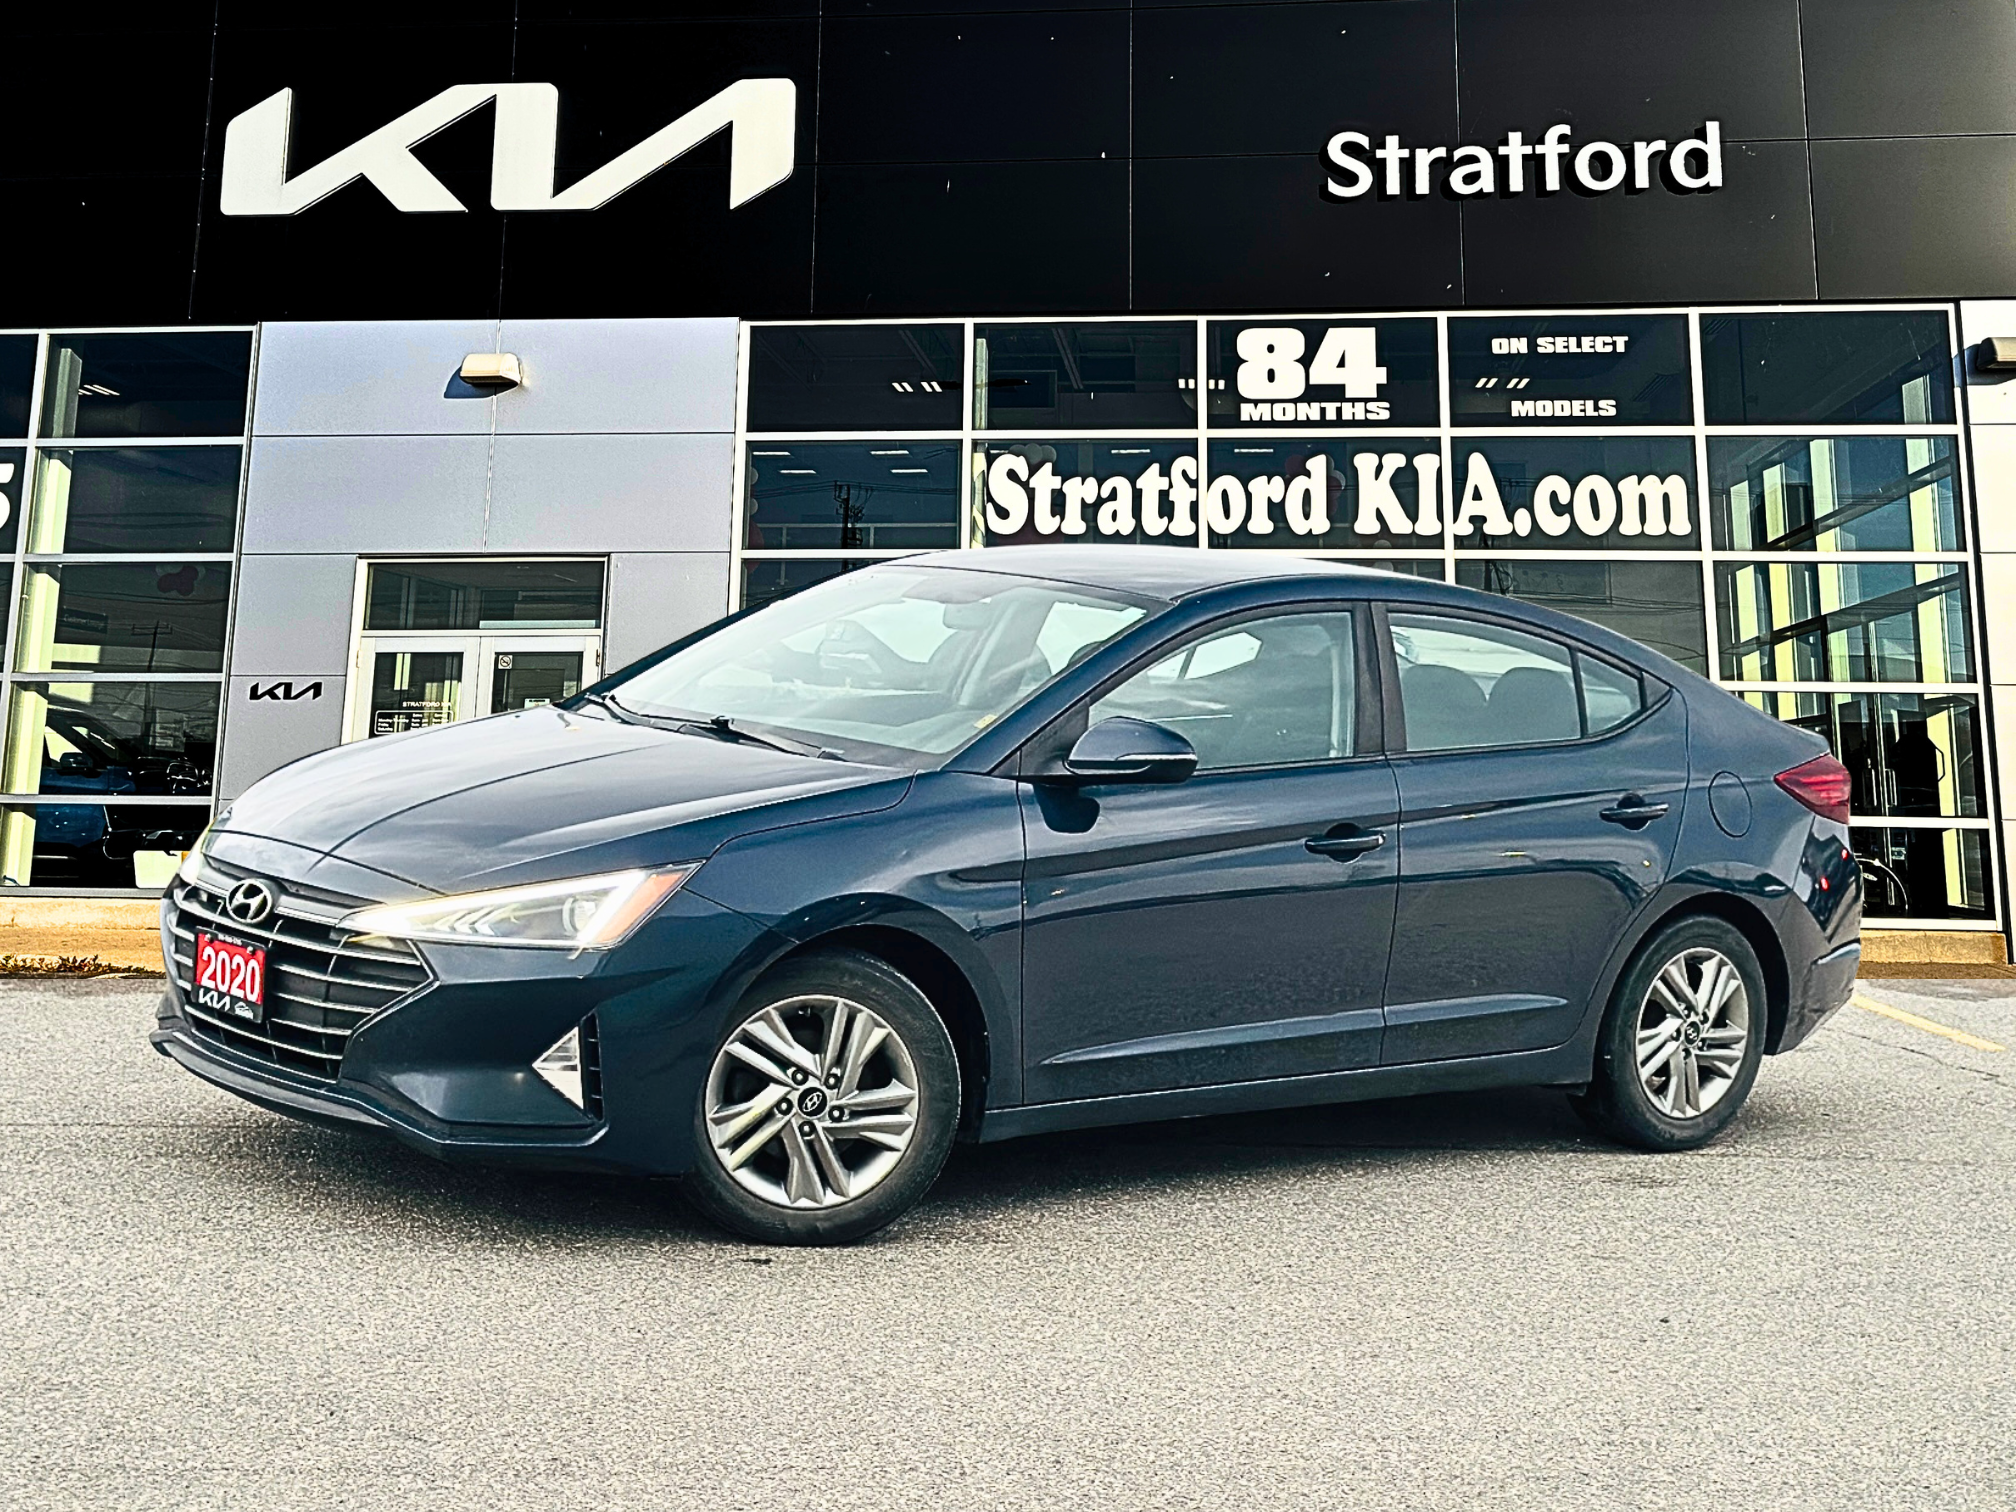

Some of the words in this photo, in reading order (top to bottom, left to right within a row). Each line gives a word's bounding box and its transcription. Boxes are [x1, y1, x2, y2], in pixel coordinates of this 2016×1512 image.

[220, 78, 796, 216] KIA
[1326, 120, 1723, 197] Stratford
[1236, 327, 1387, 400] 84
[1491, 337, 1528, 355] ON
[1536, 335, 1628, 354] SELECT
[1240, 401, 1391, 421] MONTHS
[1511, 399, 1617, 417] MODELS
[986, 453, 1331, 537] Stratford
[1353, 451, 1692, 537] KIA.com
[249, 681, 323, 701] KIA
[201, 946, 260, 1002] 2020
[198, 987, 231, 1012] KIA
